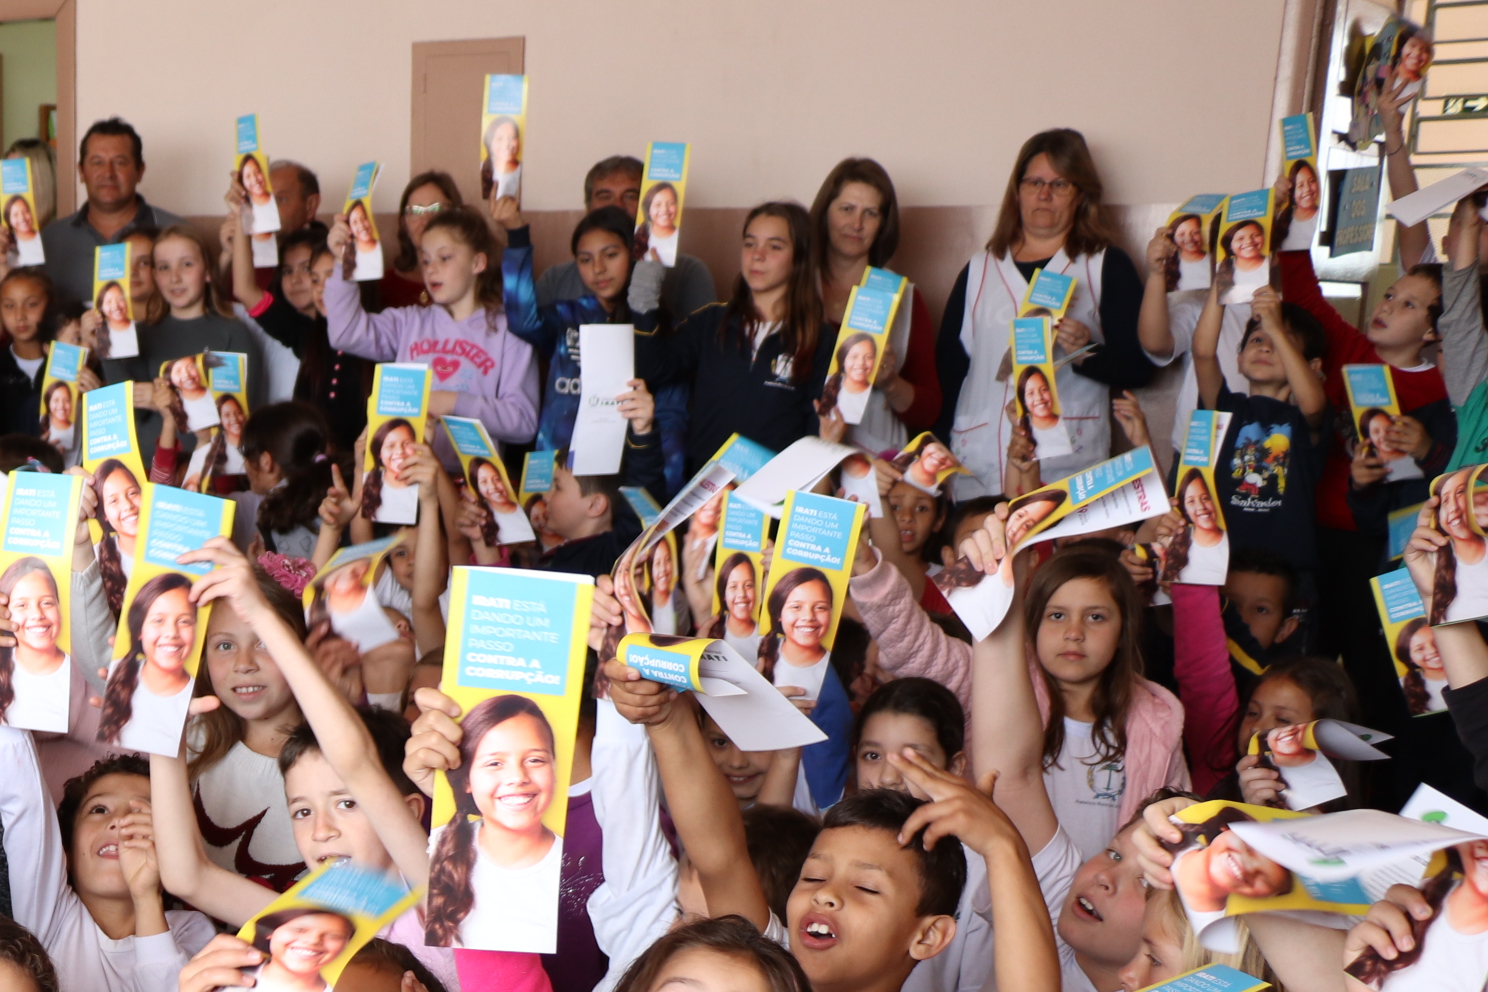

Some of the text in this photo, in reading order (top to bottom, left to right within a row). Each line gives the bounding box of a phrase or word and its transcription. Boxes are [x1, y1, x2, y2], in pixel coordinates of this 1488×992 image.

[409, 337, 496, 376] HOLLISTER
[1132, 478, 1150, 512] ESTRAS
[795, 506, 838, 520] IRATI ESTÁ
[794, 515, 838, 529] DANDO UM
[790, 531, 816, 541] PASSO
[792, 523, 842, 538] IMPORTANTE
[725, 538, 759, 547] CORRUPÇÃO!
[788, 539, 821, 552] CONTRA
[787, 548, 840, 564] CORRUPÇÃO!
[472, 595, 547, 613] IRATI ESTÁ
[471, 609, 550, 628] DANDO UM
[469, 624, 559, 643] IMPORTANTE
[468, 638, 514, 652] PASSO
[466, 652, 541, 669] CONTRA A
[629, 654, 685, 672] CORRUPÇÃO!
[465, 666, 561, 684] CORRUPÇÃO!
[651, 670, 687, 683] CONTRA
[1184, 976, 1209, 989] DANDO
[1196, 972, 1232, 988] IRATI ESTÁ
